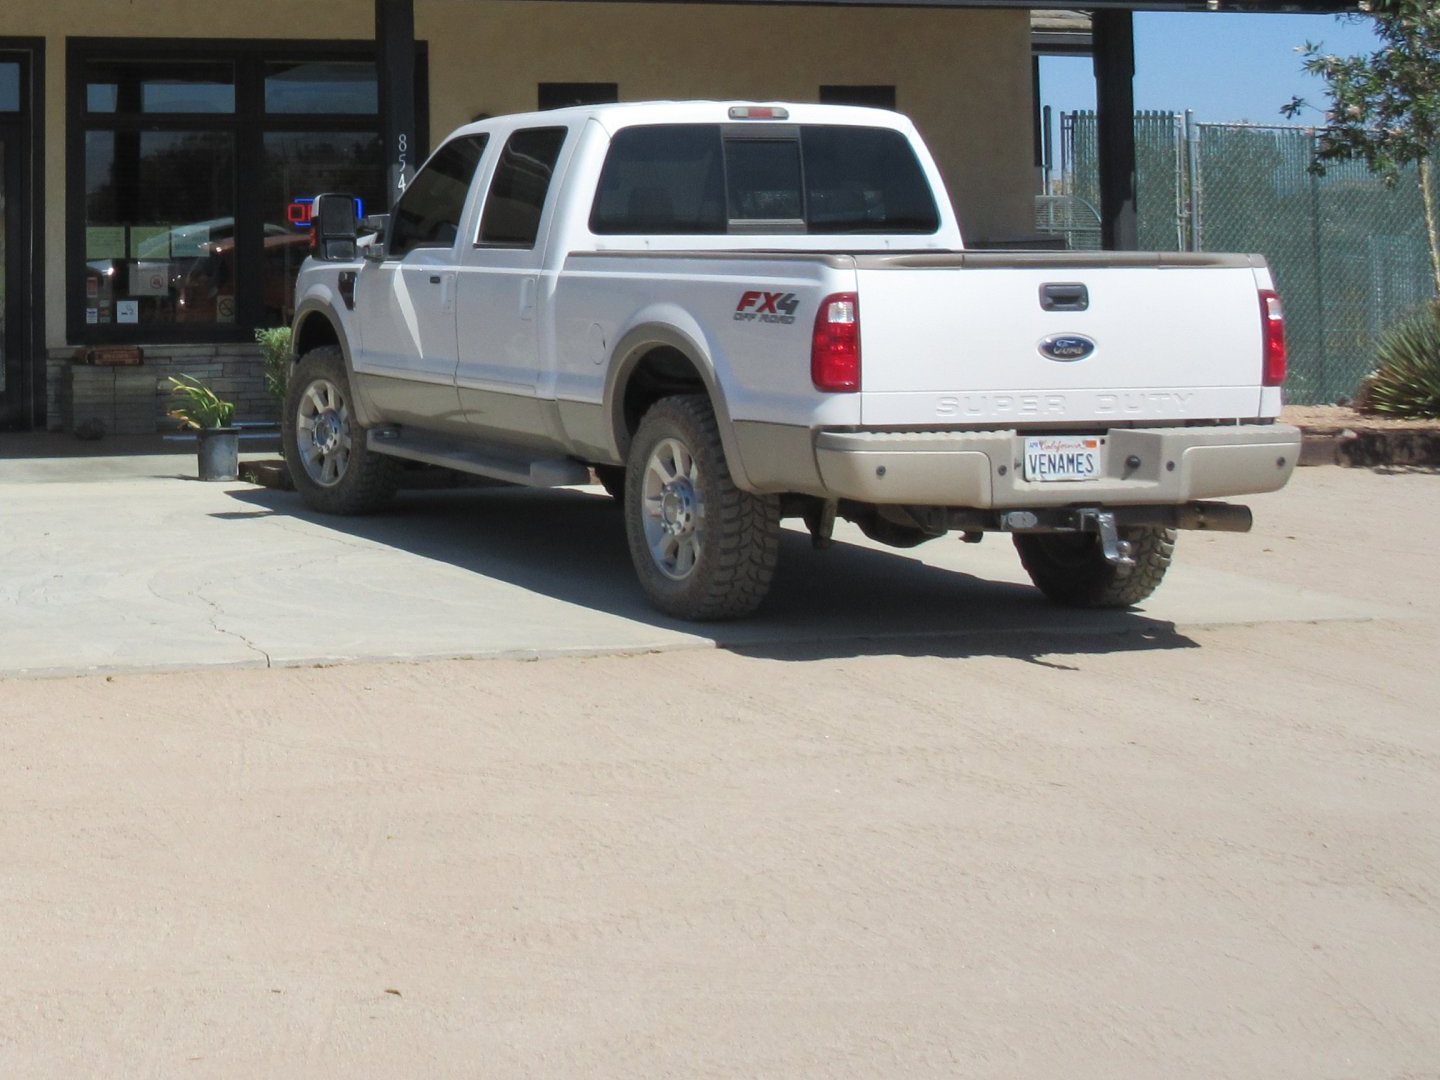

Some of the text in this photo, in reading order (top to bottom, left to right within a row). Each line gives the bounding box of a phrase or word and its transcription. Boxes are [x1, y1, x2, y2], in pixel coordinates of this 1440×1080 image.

[736, 290, 800, 315] FX4
[936, 392, 1194, 417] SUPER DUTY
[1028, 453, 1094, 474] VENAMES
